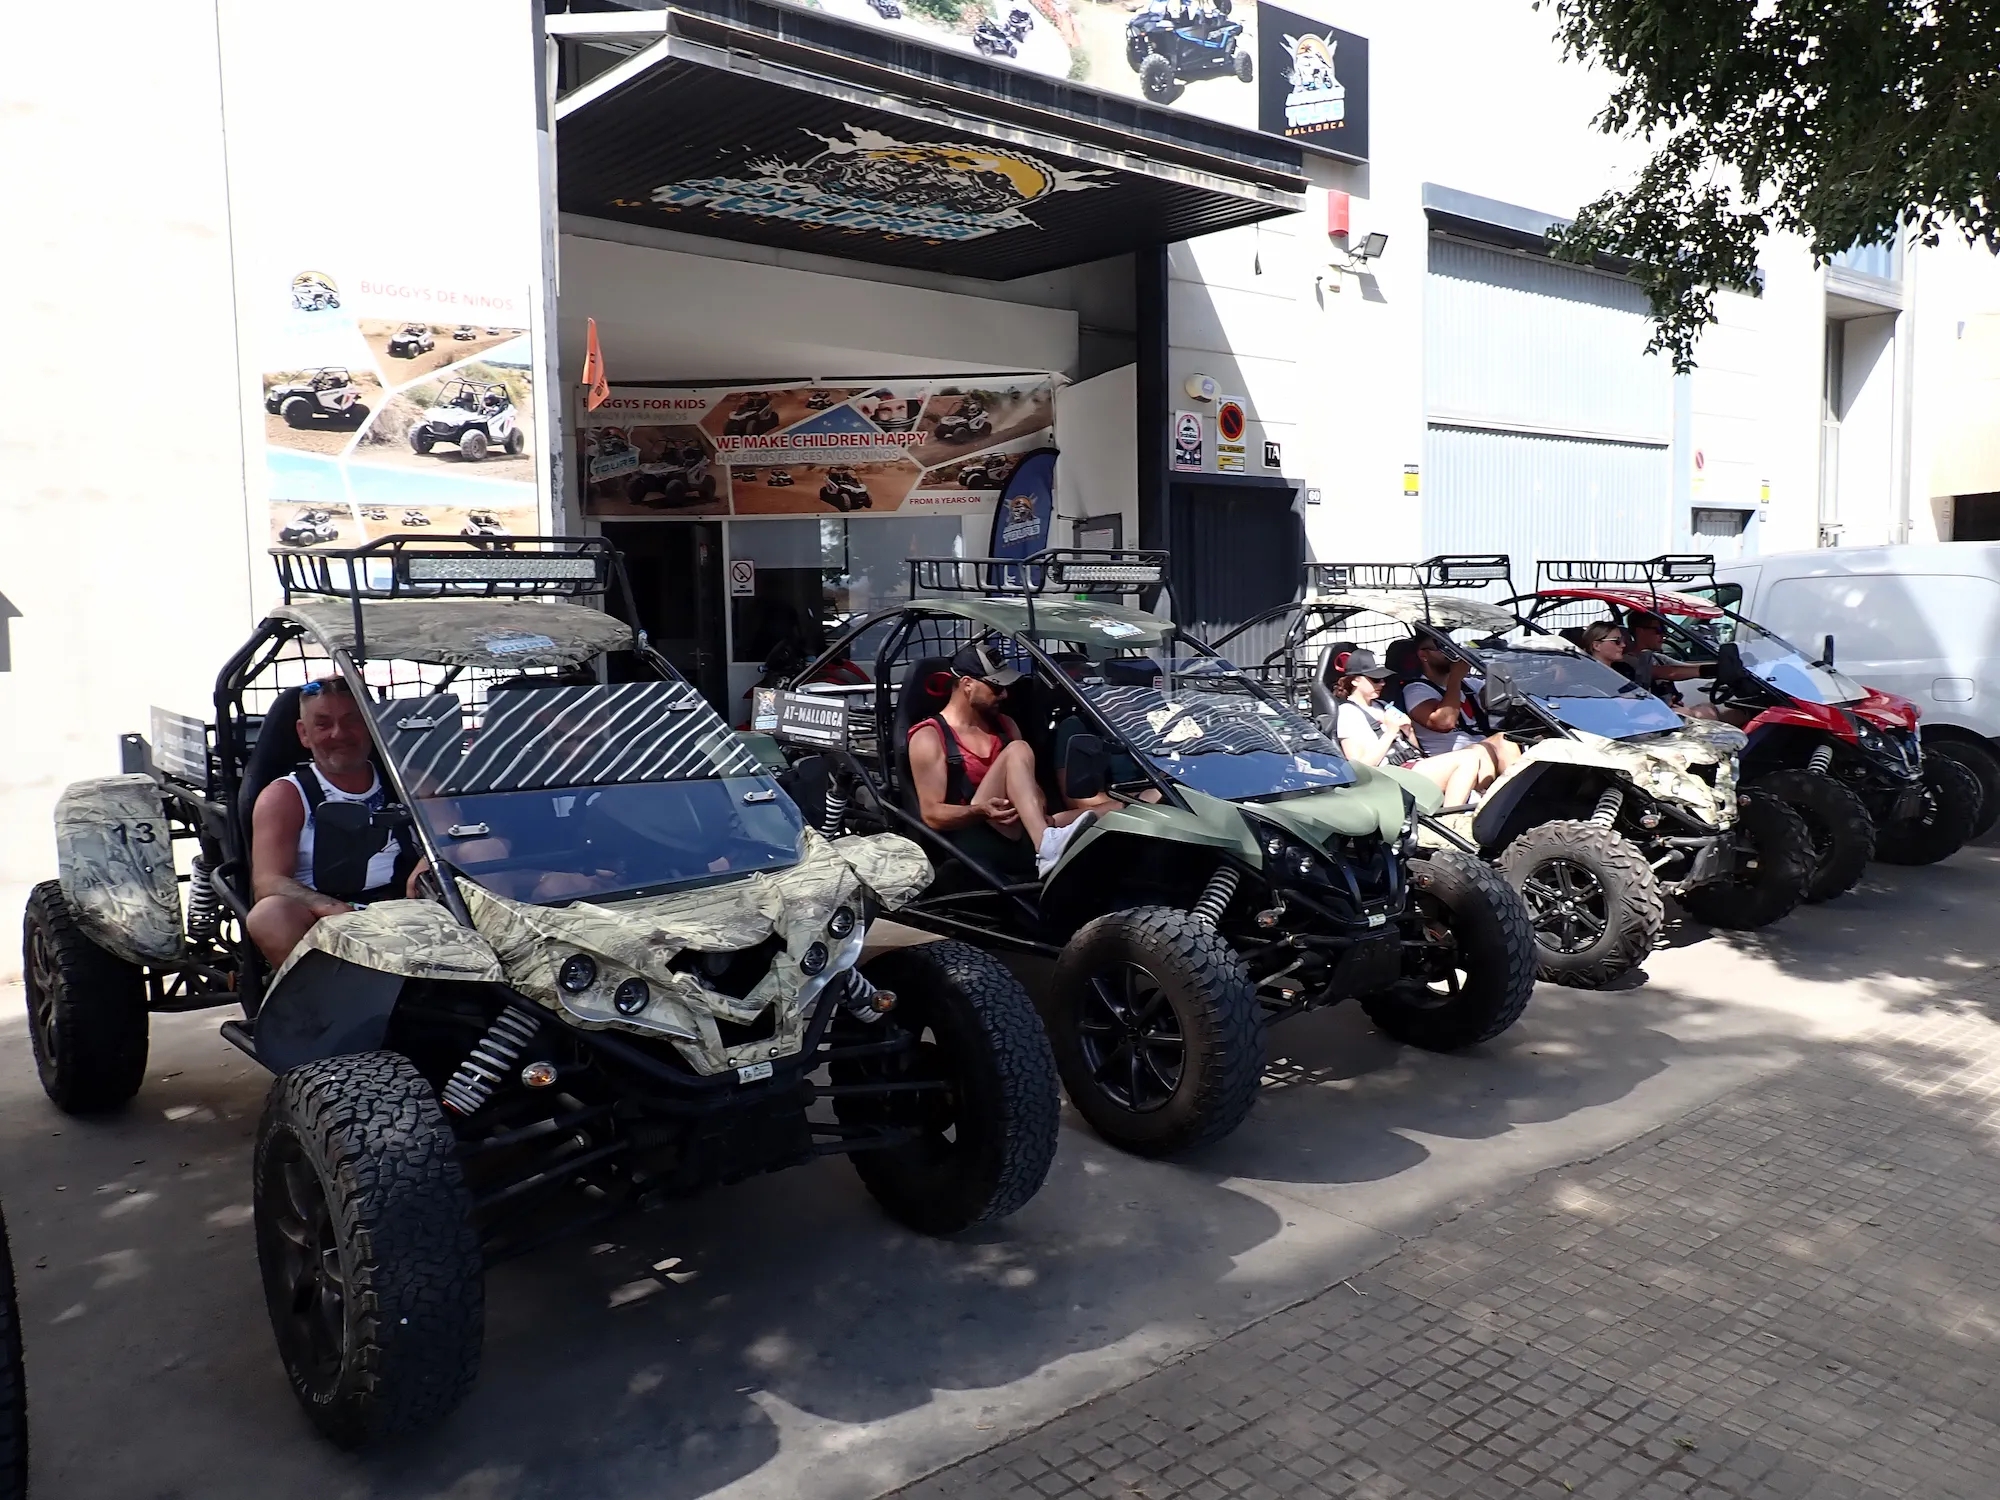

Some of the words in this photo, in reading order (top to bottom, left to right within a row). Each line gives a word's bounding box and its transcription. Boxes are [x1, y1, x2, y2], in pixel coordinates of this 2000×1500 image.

[1285, 121, 1344, 136] MALLORCA
[361, 281, 432, 301] BUGGYS
[437, 290, 458, 304] DE
[583, 398, 639, 409] BGGYS
[643, 399, 671, 409] FOR
[674, 399, 706, 409] KIDS
[716, 437, 743, 449] WE
[744, 435, 788, 448] MAKE
[792, 433, 871, 447] CHILDREN
[874, 432, 926, 446] HAPPY
[593, 456, 638, 474] TOURS
[716, 452, 775, 464] HACEMOS
[778, 451, 823, 462] FELICES
[826, 450, 834, 460] A
[836, 450, 858, 460] LOS
[1002, 525, 1040, 543] TOURS
[783, 705, 843, 727] AT-MALLORCA
[112, 822, 157, 845] 13
